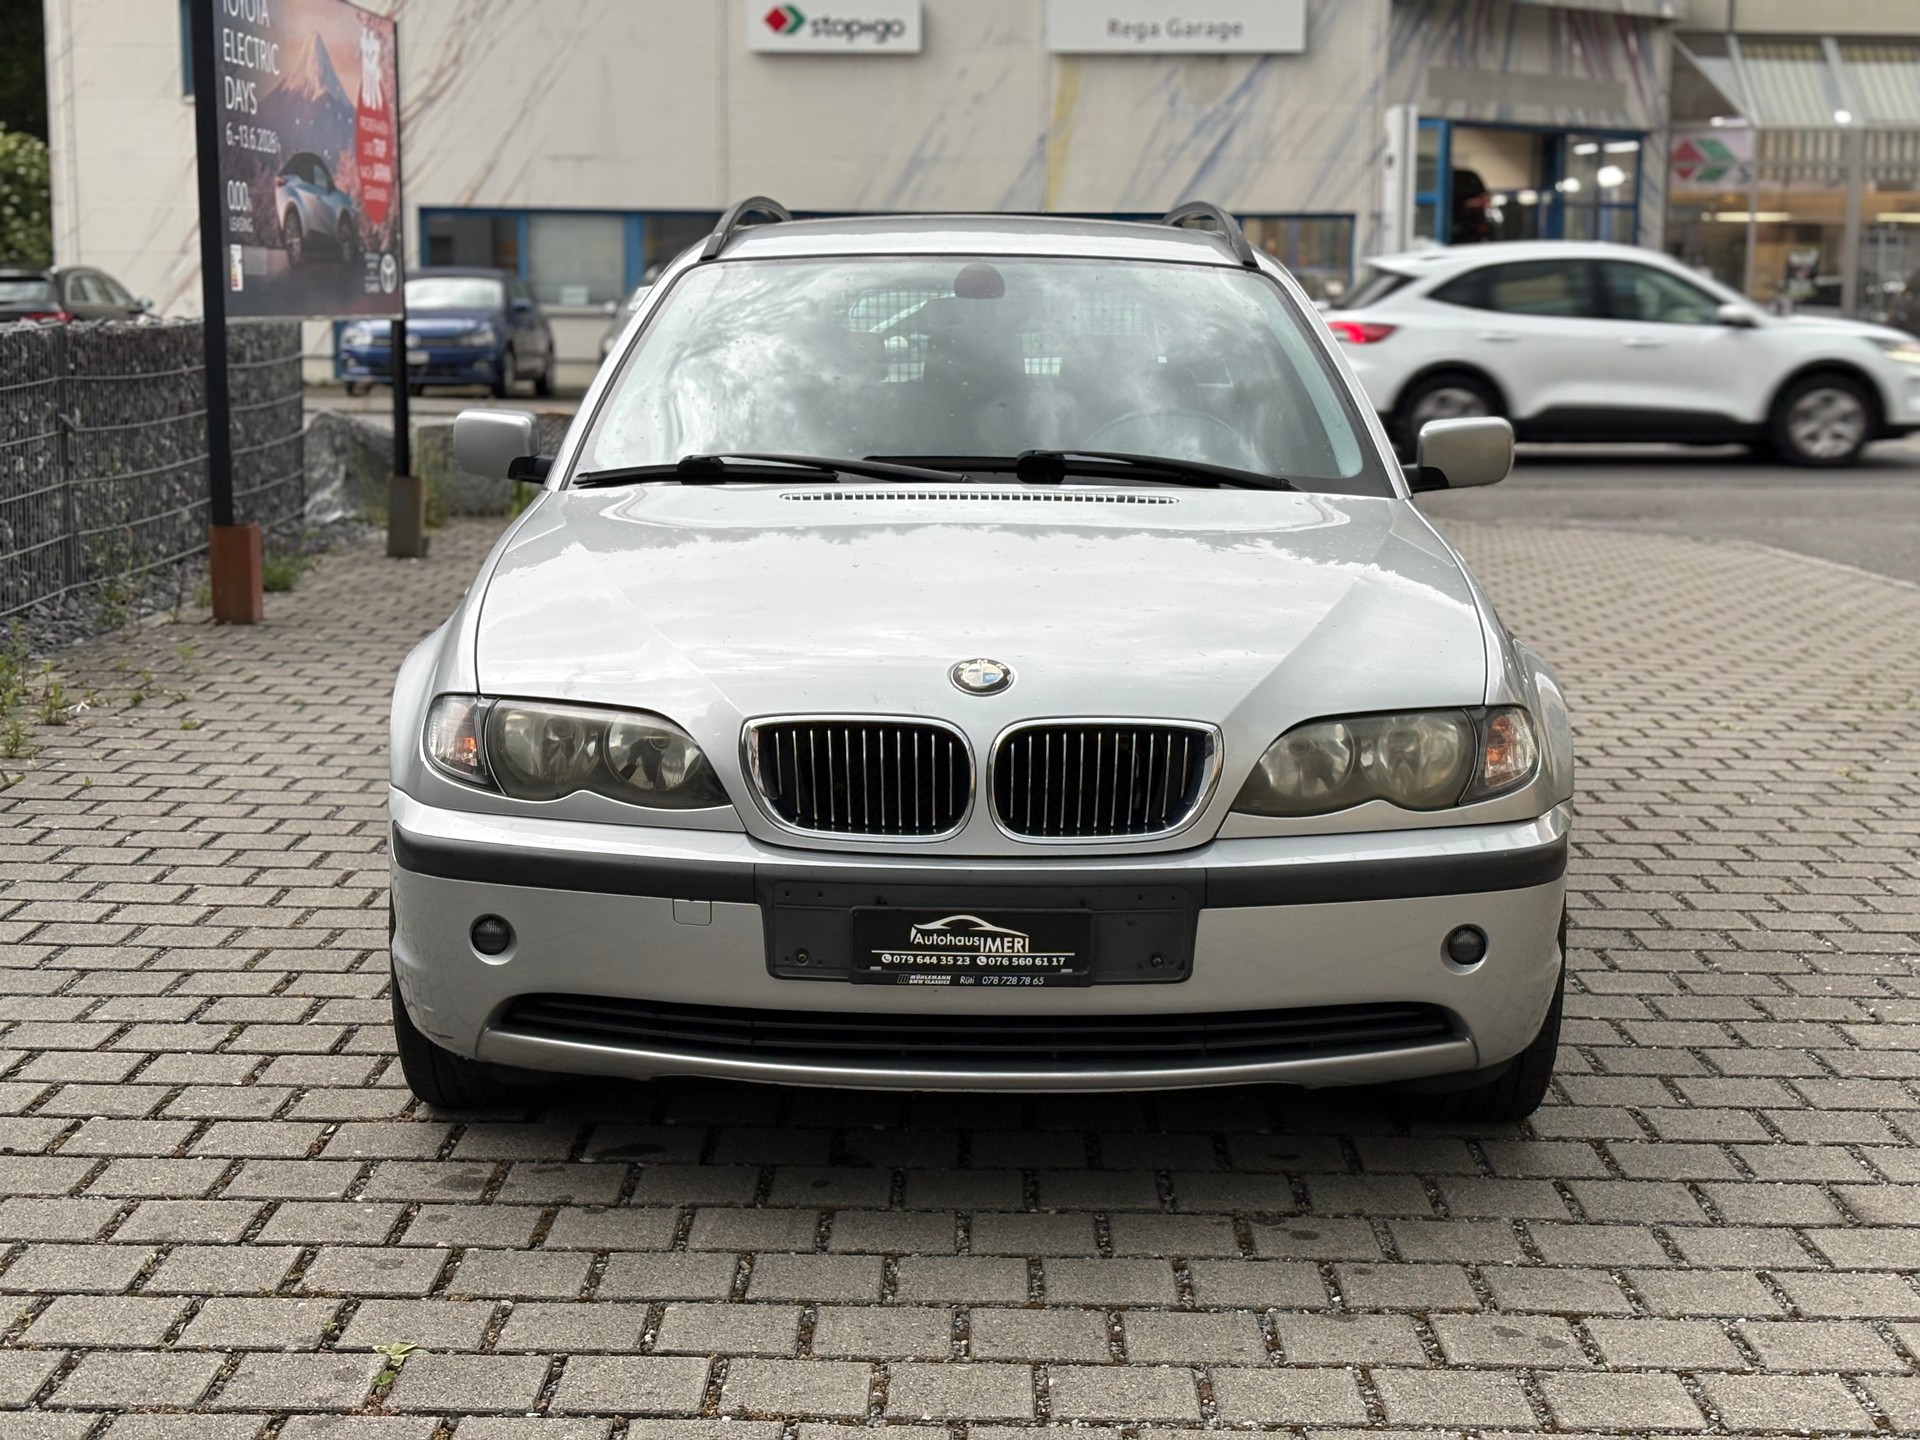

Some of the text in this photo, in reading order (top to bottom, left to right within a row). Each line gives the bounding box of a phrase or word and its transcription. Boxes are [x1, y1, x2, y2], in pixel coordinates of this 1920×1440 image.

[1106, 17, 1243, 43] Rega Garage
[223, 27, 280, 76] ELECTRIC
[225, 75, 258, 115] DAYS
[914, 933, 1030, 953] Autohaus IMERI
[893, 955, 1066, 966] 079 644 35 23 076 560 61 17
[982, 976, 999, 985] 078
[1000, 976, 1018, 985] 728
[1019, 976, 1031, 985] 78
[1032, 976, 1045, 985] 65
